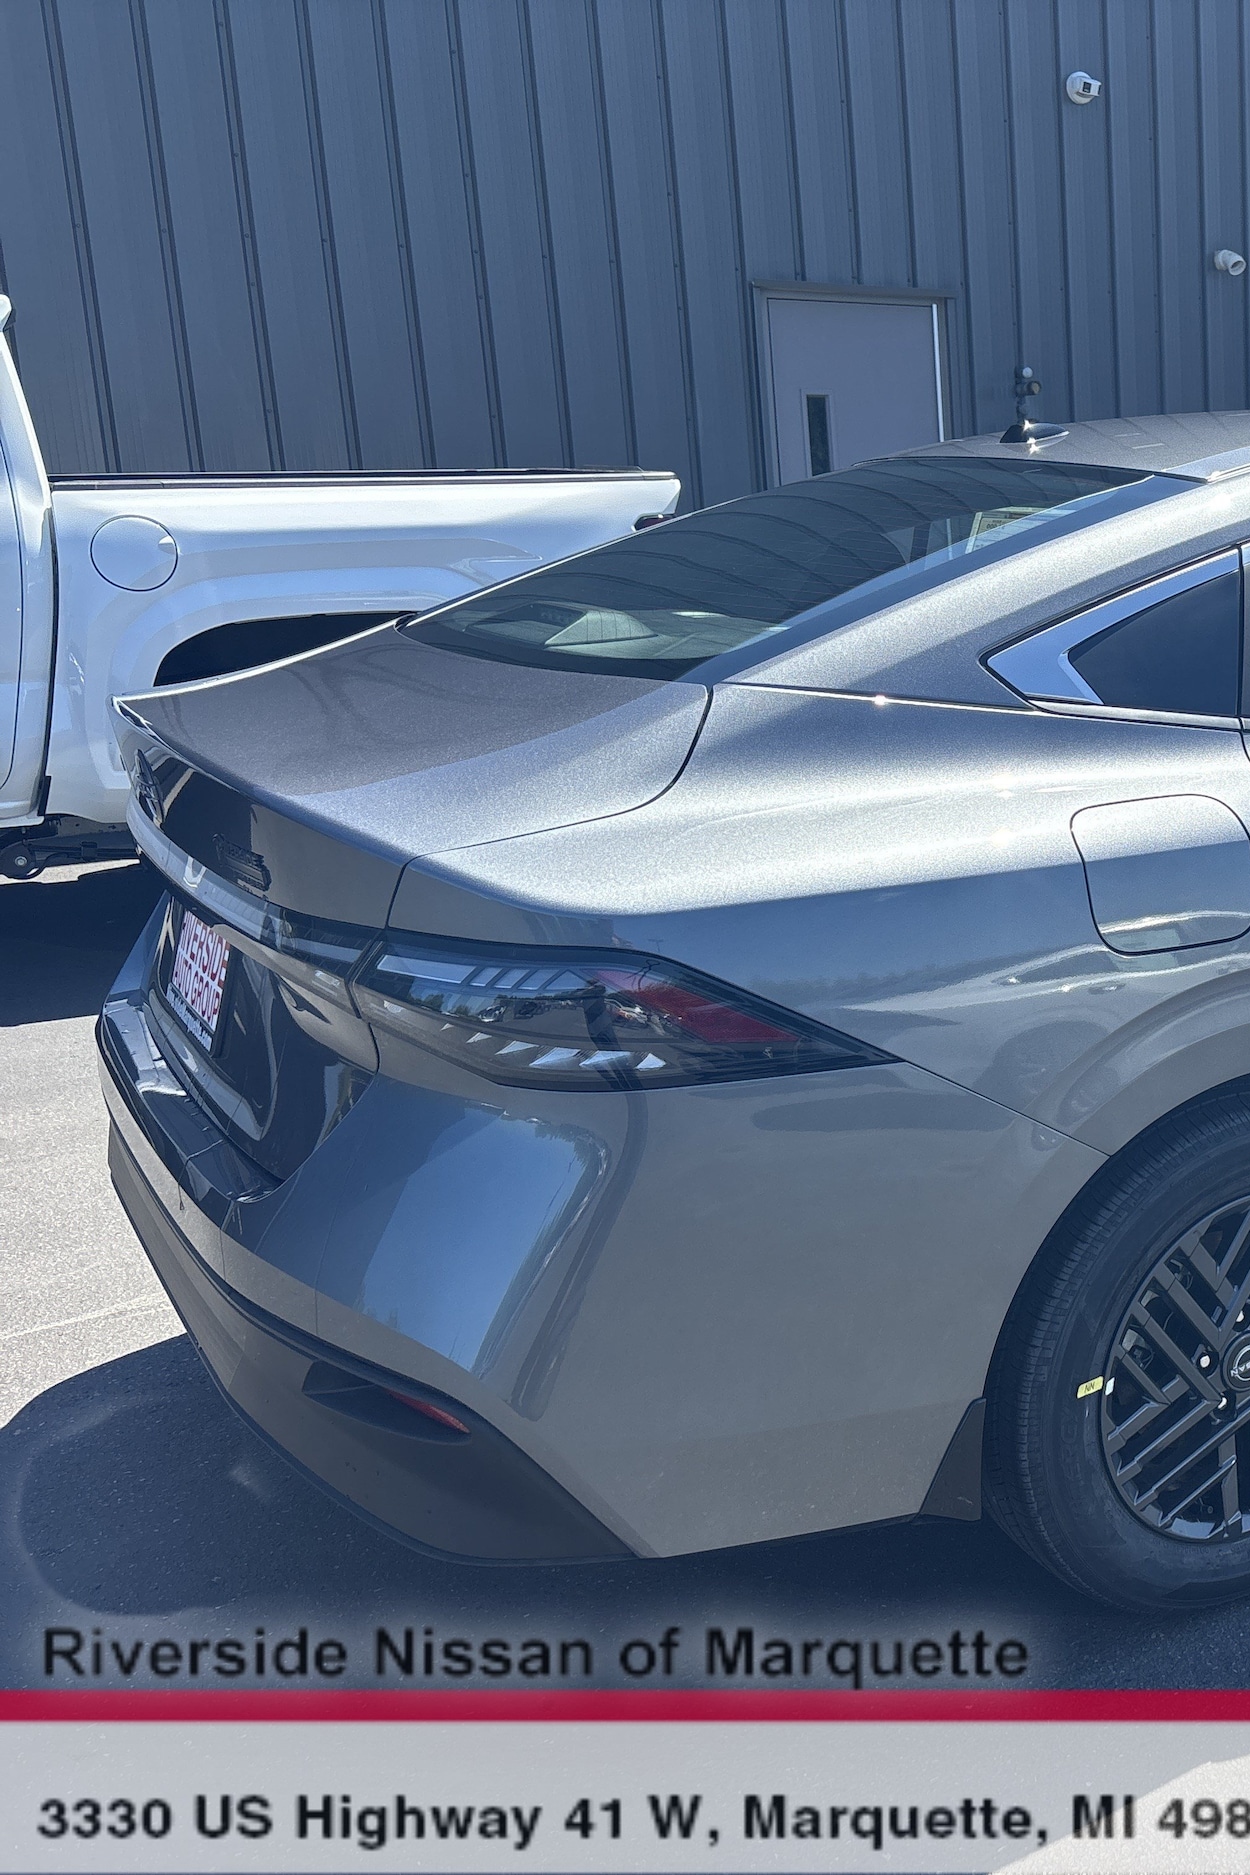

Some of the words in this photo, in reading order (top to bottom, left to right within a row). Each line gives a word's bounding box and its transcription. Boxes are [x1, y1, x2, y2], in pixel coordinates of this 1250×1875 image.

[173, 947, 192, 999] AUTO
[191, 969, 221, 1030] GROUP
[180, 910, 231, 989] RIVERSIDE
